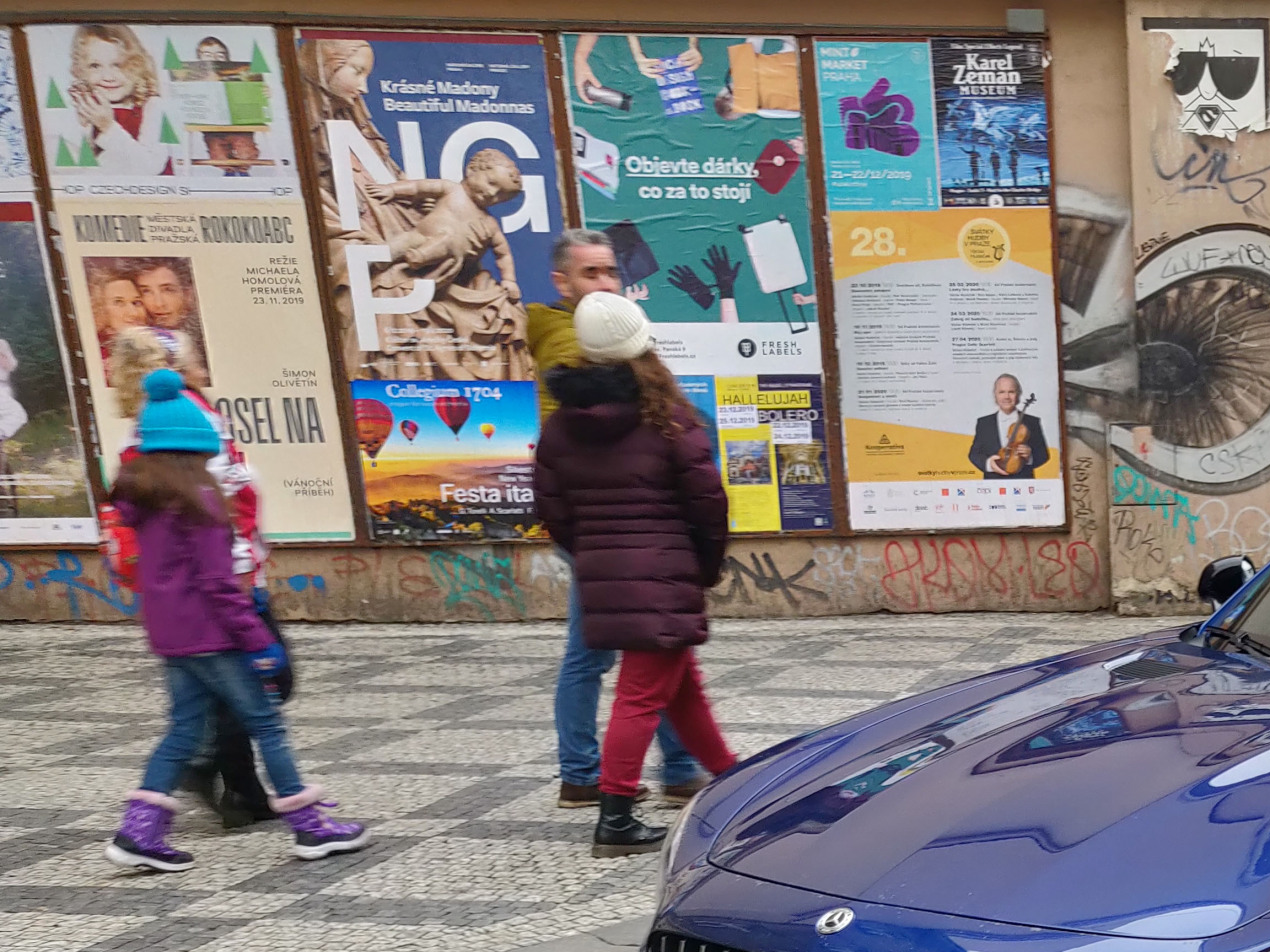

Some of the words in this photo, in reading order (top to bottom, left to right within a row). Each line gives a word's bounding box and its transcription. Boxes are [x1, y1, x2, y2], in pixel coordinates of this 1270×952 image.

[821, 60, 868, 70] MARKET
[965, 53, 1014, 70] Karel
[952, 65, 1022, 85] Zeman
[379, 79, 436, 95] Krásné
[436, 81, 500, 99] Madony
[959, 85, 1017, 95] MUSEUM
[382, 97, 454, 112] Beautiful
[455, 99, 536, 114] Madonnas
[624, 155, 700, 176] Objevte
[702, 156, 760, 177] dárky,
[638, 185, 663, 199] co
[665, 185, 686, 199] za
[689, 183, 710, 199] to
[714, 183, 752, 203] stojí
[74, 215, 148, 243] KOMEDIE
[850, 226, 906, 257] 28.
[269, 255, 298, 265] REŽIE
[246, 266, 300, 275] MICHAELA
[242, 275, 302, 285] HOMOLOVÁ
[250, 285, 303, 295] PREMIÉRA
[282, 368, 316, 377] ŠIMON
[272, 377, 318, 387] OLIVĚTÍN
[385, 383, 460, 401] Collegium
[463, 385, 503, 402] 1704
[722, 393, 809, 406] HALLELUJAH
[282, 397, 326, 443] NA
[758, 409, 819, 421] BOLERO
[283, 477, 334, 488] (VÁNOČNÍ
[440, 484, 502, 503] Festa
